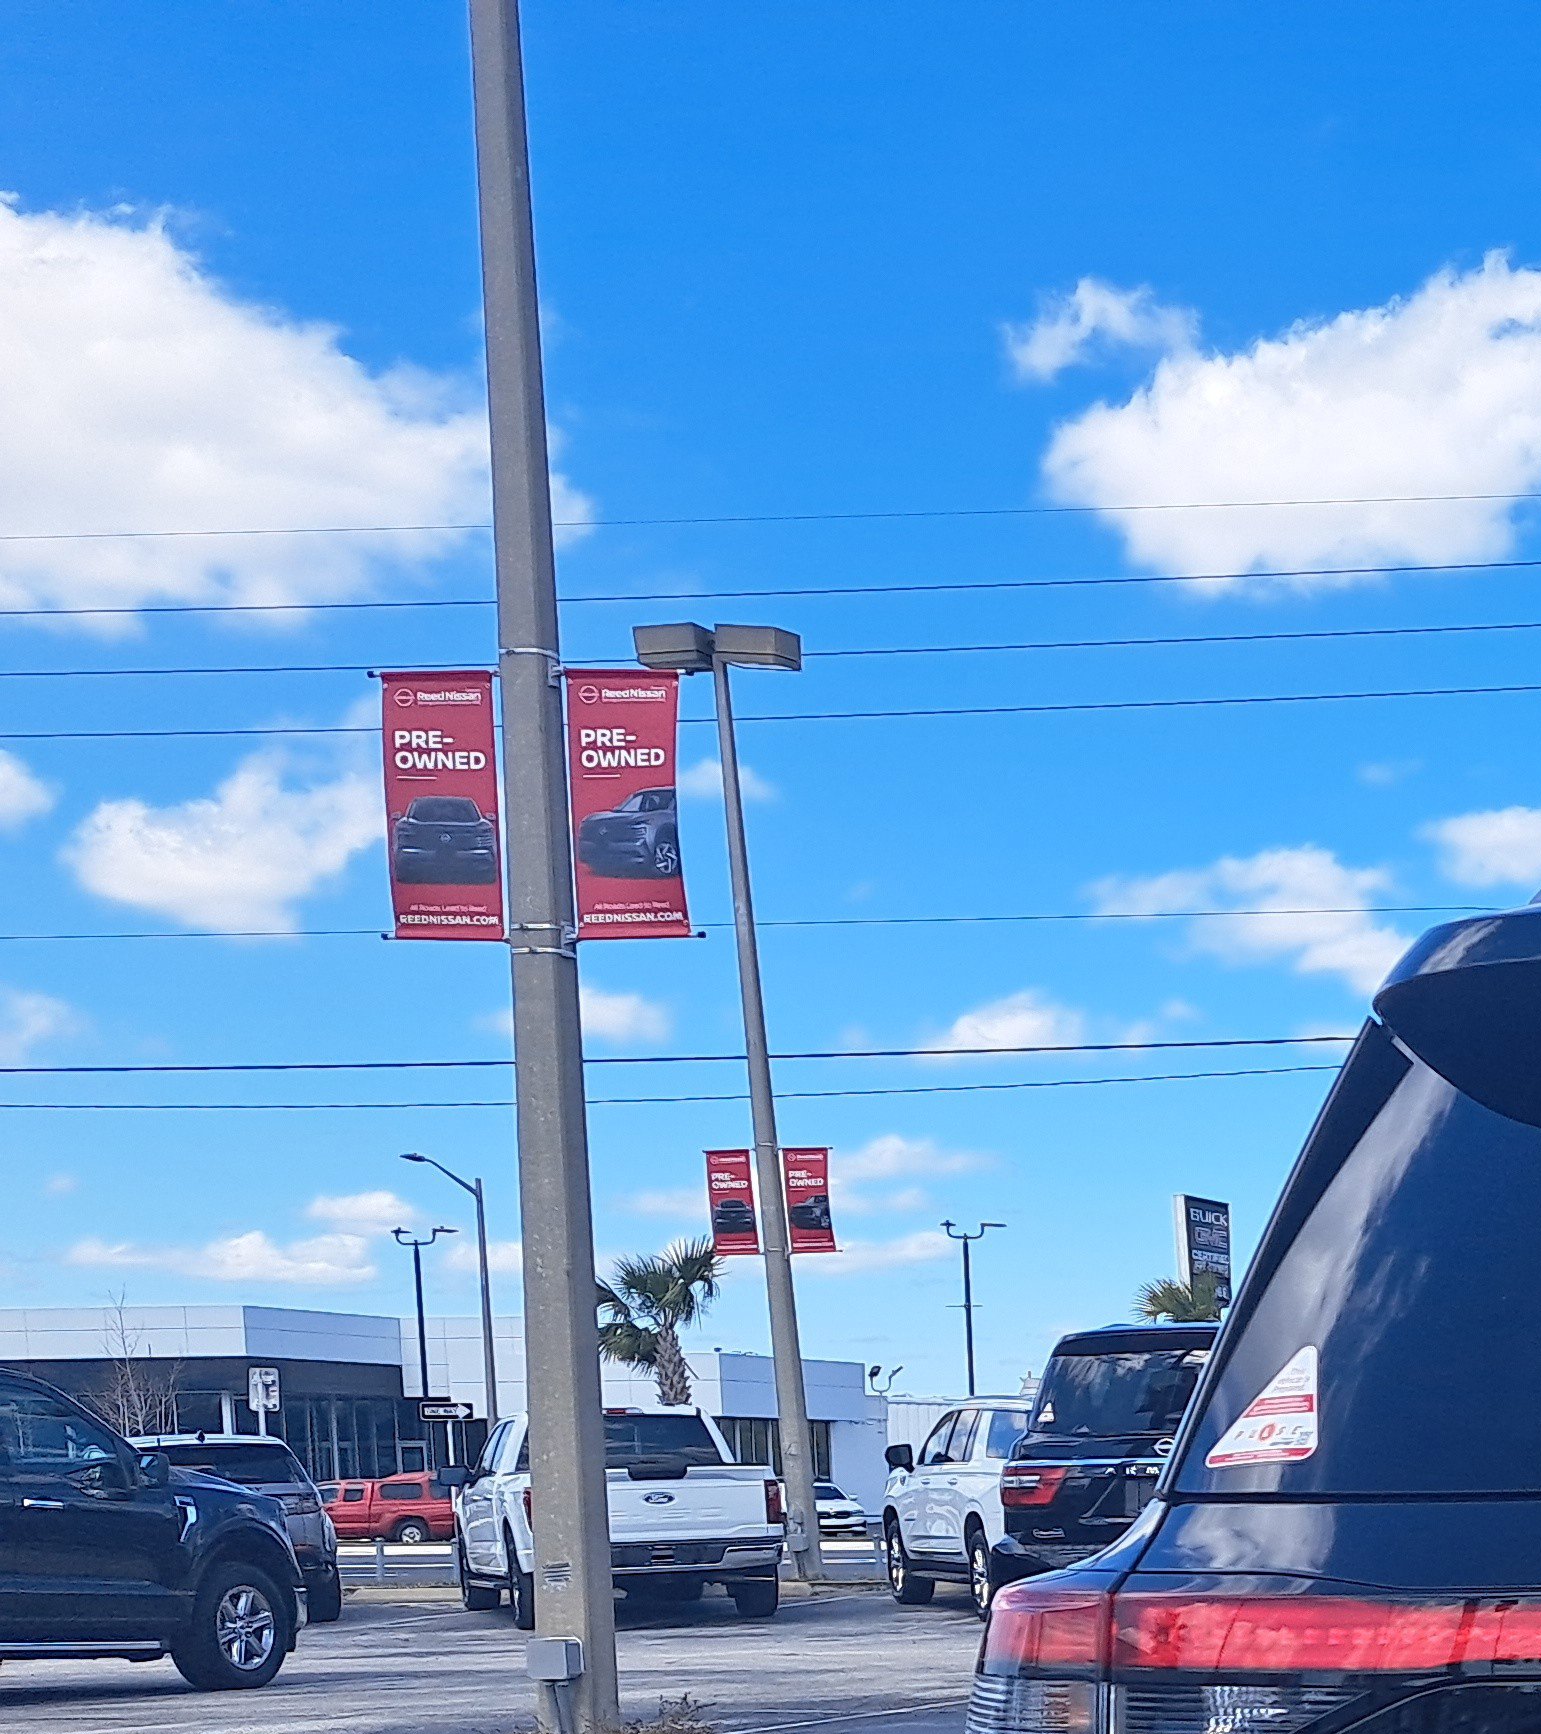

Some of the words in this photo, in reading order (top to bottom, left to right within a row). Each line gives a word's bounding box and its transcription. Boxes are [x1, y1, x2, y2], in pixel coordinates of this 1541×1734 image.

[394, 730, 454, 749] PRE-
[580, 728, 637, 747] PRE-
[394, 751, 486, 770] OWNED
[581, 748, 666, 768] OWNED
[1189, 1207, 1228, 1227] BUICK
